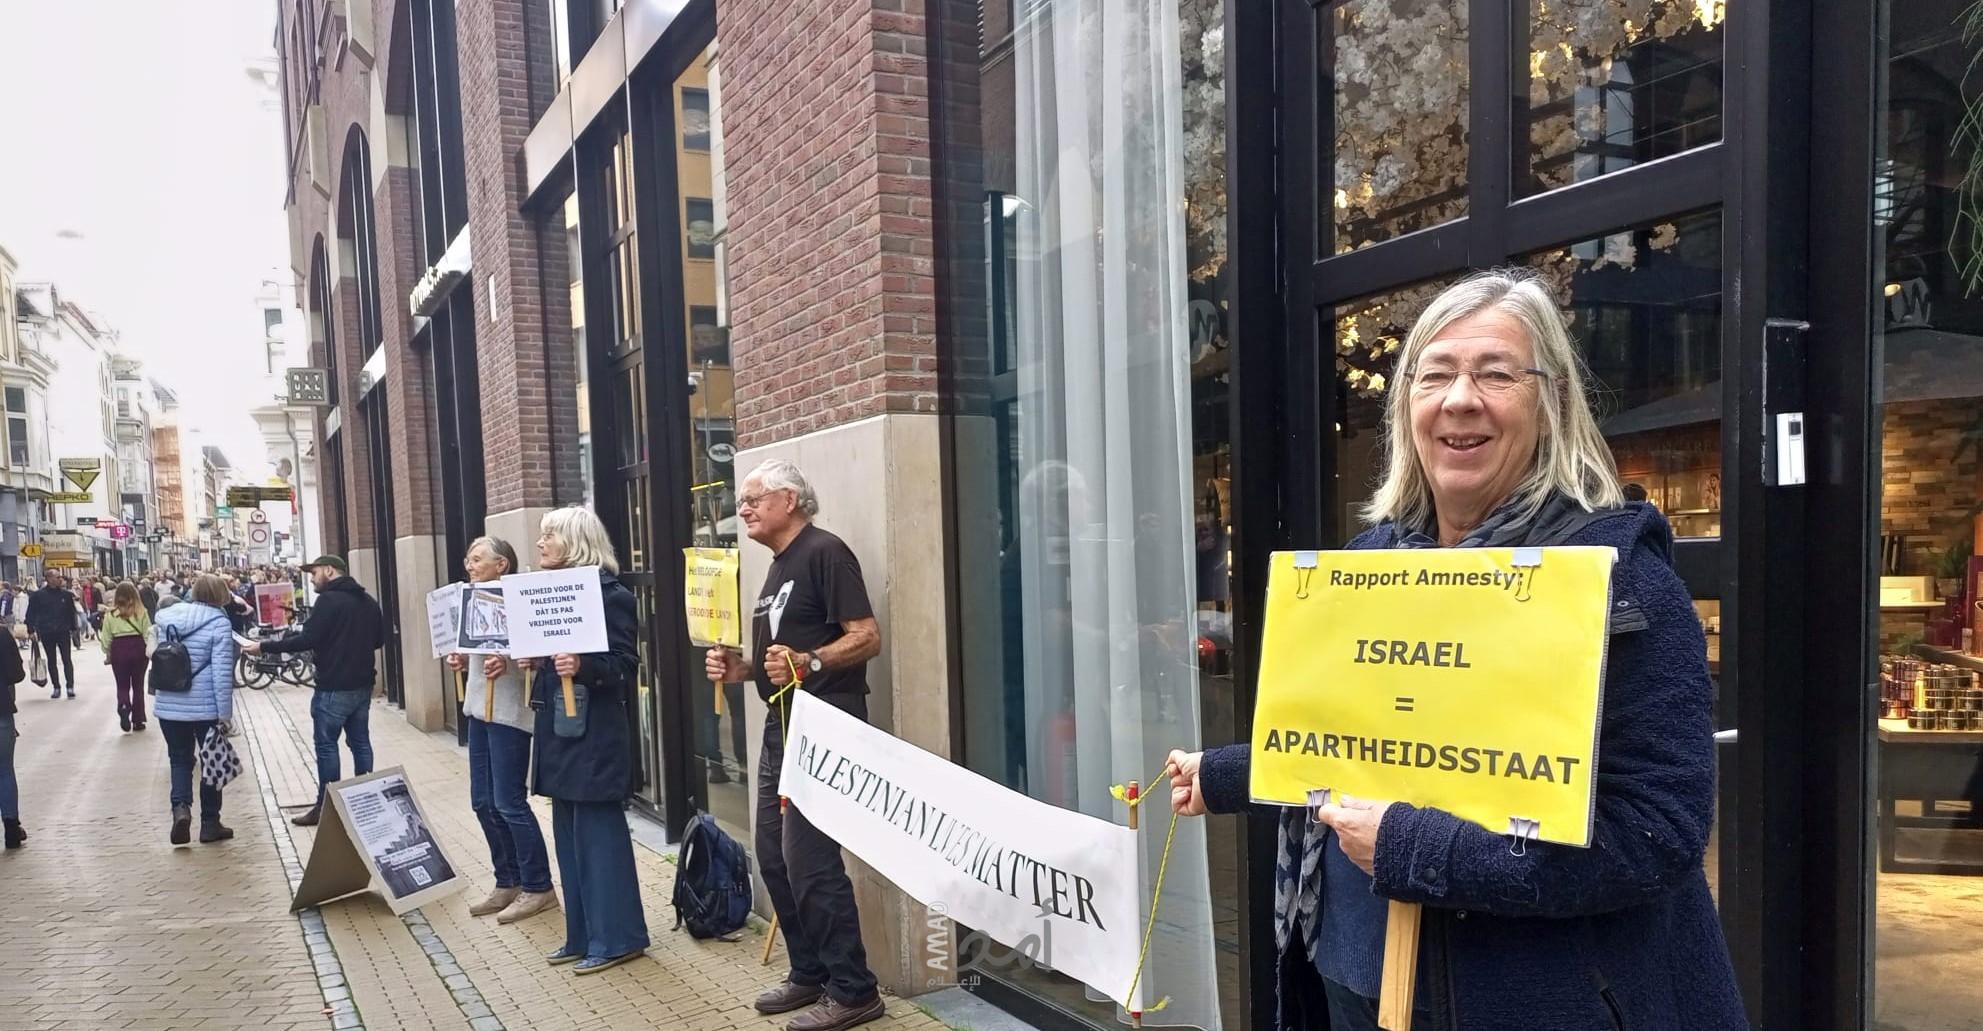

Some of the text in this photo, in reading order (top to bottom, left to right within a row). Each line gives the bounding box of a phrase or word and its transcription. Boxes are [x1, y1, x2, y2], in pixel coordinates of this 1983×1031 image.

[1330, 569, 1409, 589] Rapport
[520, 587, 552, 596] VRIJHEID
[554, 585, 573, 593] VOOR
[530, 595, 576, 605] PALESTIJNEN
[529, 619, 562, 627] VRIJHEID
[1353, 639, 1472, 669] ISRAEL
[1395, 697, 1414, 712] =
[1263, 729, 1580, 785] APARTHEIDSSTAAT
[798, 735, 1107, 932] PALESTINIAN LVES MATTER
